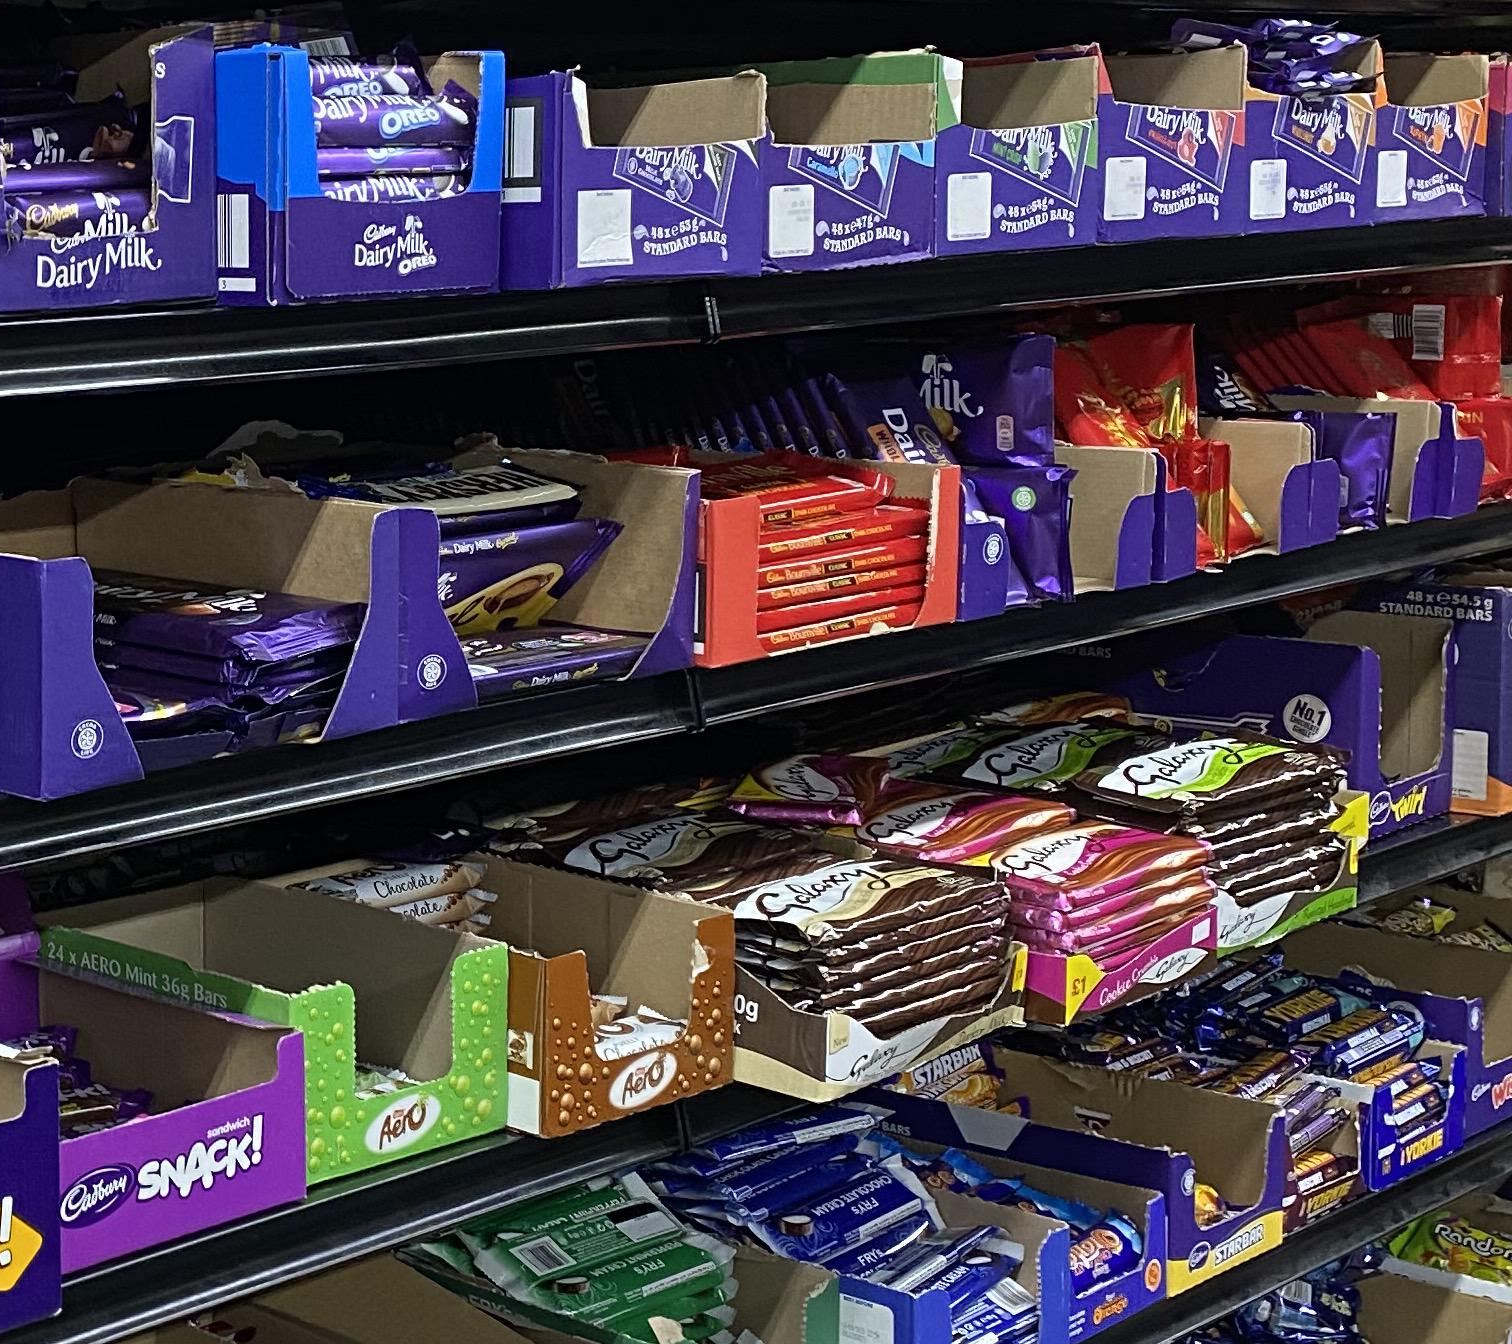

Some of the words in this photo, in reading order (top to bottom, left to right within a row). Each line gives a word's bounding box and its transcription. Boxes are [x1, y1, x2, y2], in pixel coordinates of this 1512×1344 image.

[1152, 200, 1197, 217] STANDARD
[1197, 192, 1220, 206] BARS
[999, 212, 1048, 235] STANDARD
[1049, 208, 1075, 223] BARS
[823, 232, 875, 254] STANDARD
[876, 227, 901, 241] BARS
[398, 253, 437, 276] OREO
[1379, 601, 1454, 620] STANDARD
[1455, 604, 1493, 623] BARS
[47, 941, 65, 961] 24
[68, 951, 78, 964] x
[80, 948, 122, 978] AERO
[125, 963, 158, 989] Mint
[161, 973, 189, 1001] 36g
[191, 982, 228, 1009] Bars
[1099, 979, 1132, 1006] Cookie
[206, 1117, 251, 1139] sandwich
[137, 1114, 263, 1201] SNACK!
[1214, 1223, 1265, 1266] STARBAR
